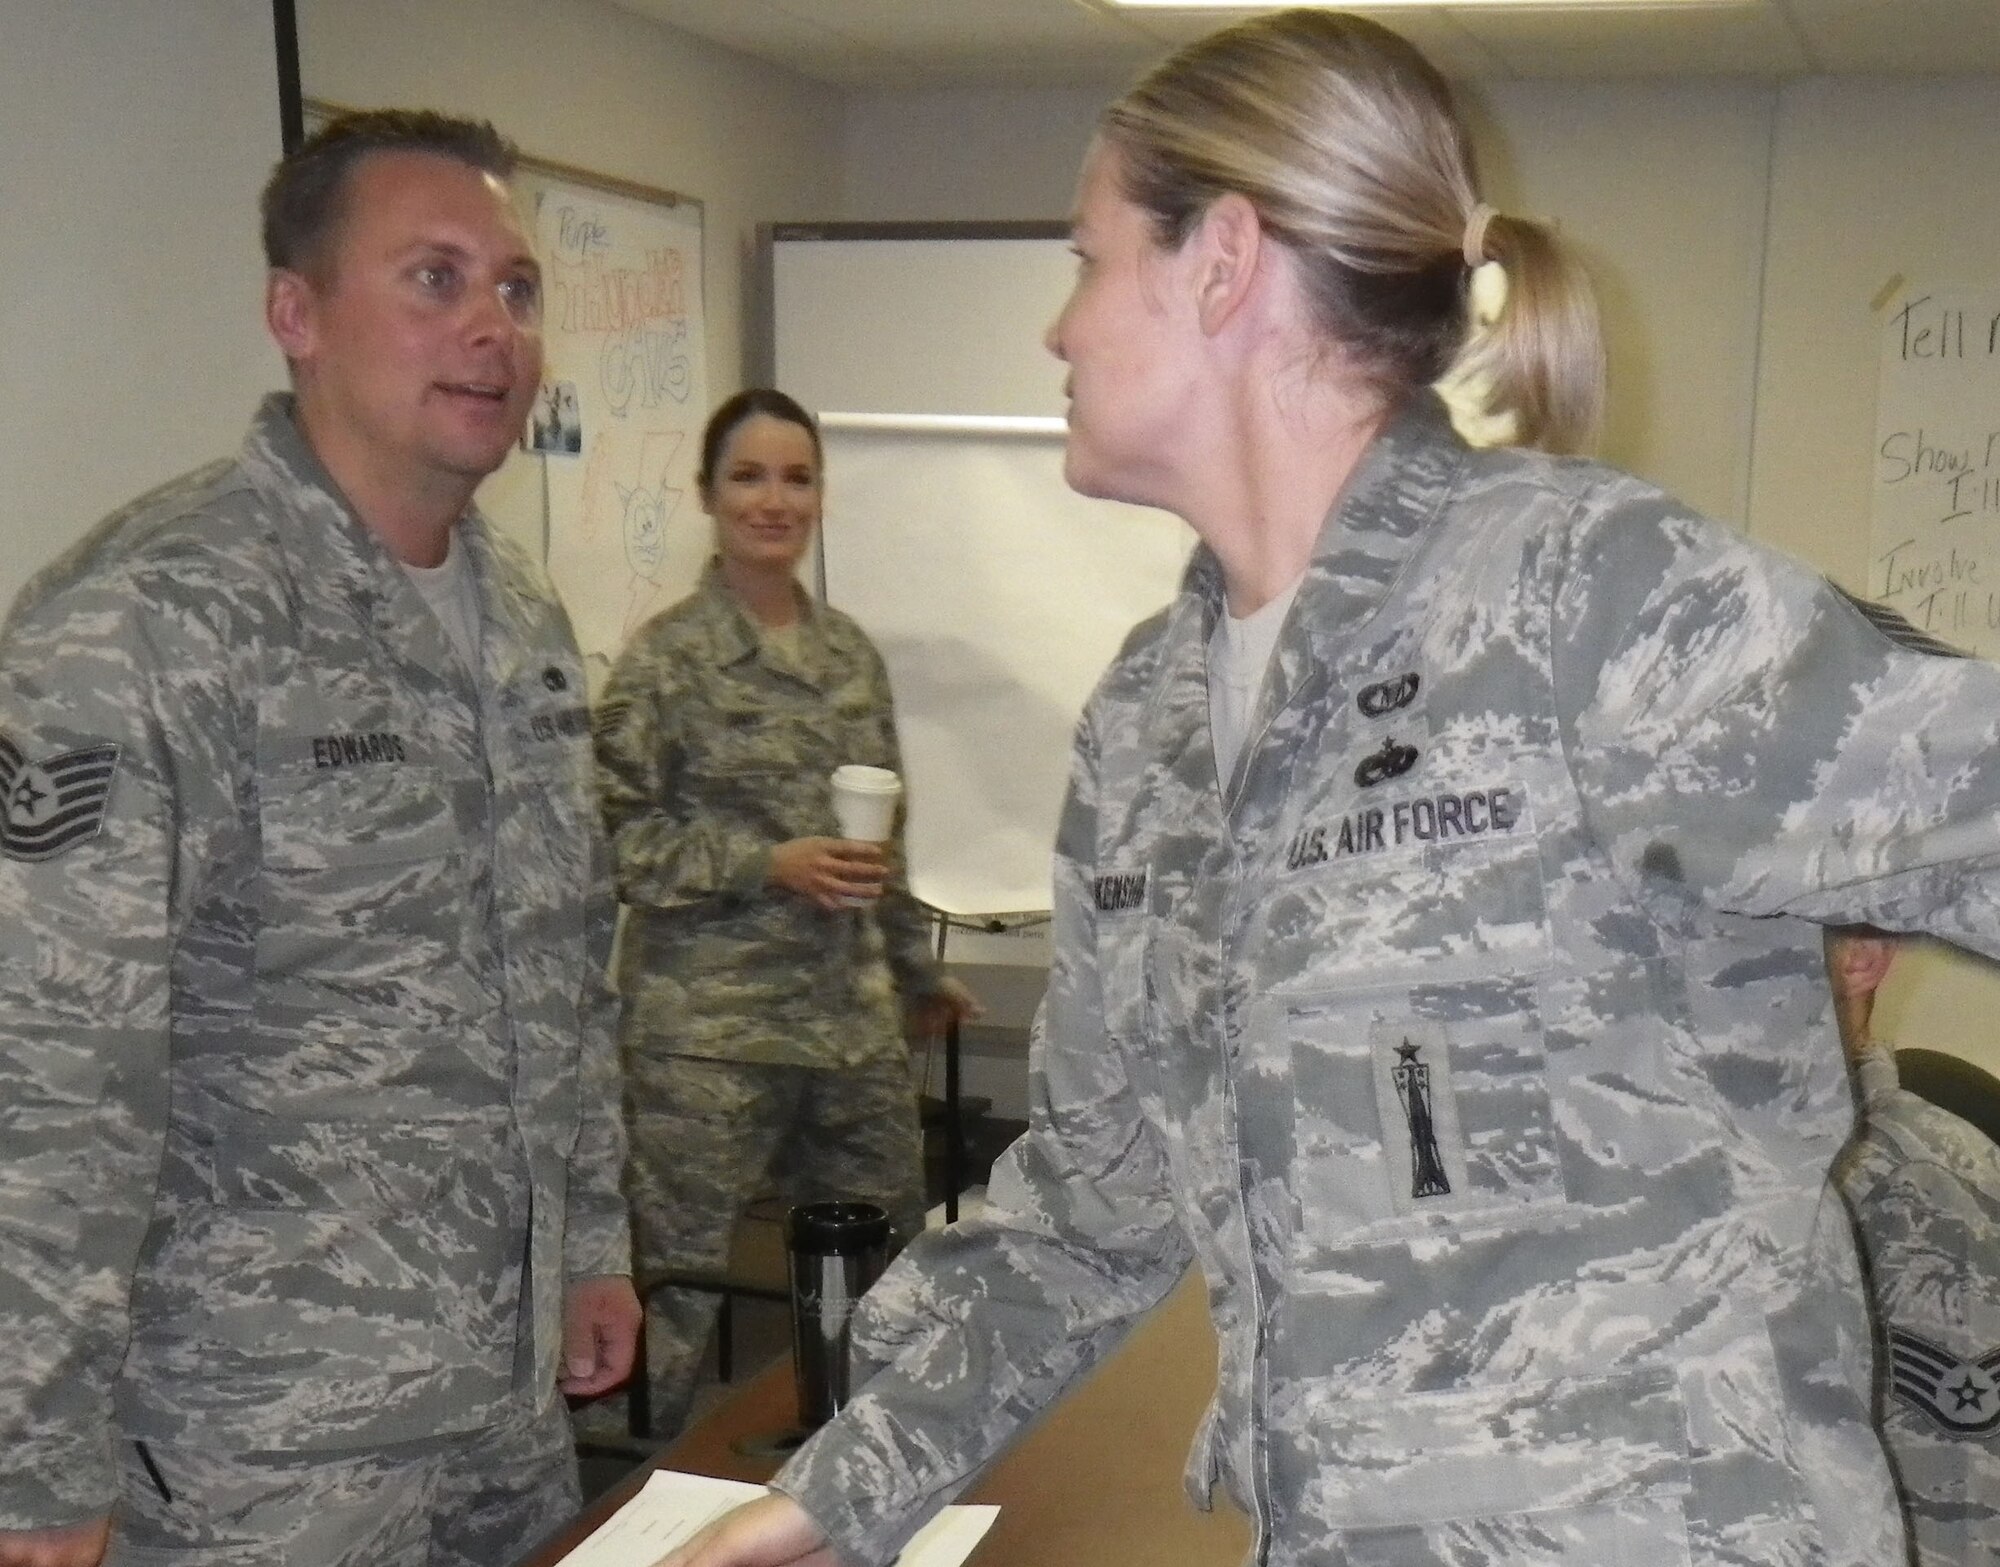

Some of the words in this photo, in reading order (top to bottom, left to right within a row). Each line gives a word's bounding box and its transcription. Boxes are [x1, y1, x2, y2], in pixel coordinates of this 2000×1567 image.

[558, 206, 611, 255] Purple
[1890, 295, 1963, 360] Tell
[1881, 429, 1969, 484] Show
[1877, 539, 1981, 600] Involve
[313, 733, 405, 768] EDWARDS
[1286, 827, 1328, 870] U.S.
[1335, 812, 1385, 858] AIR
[1394, 788, 1515, 844] FORCE
